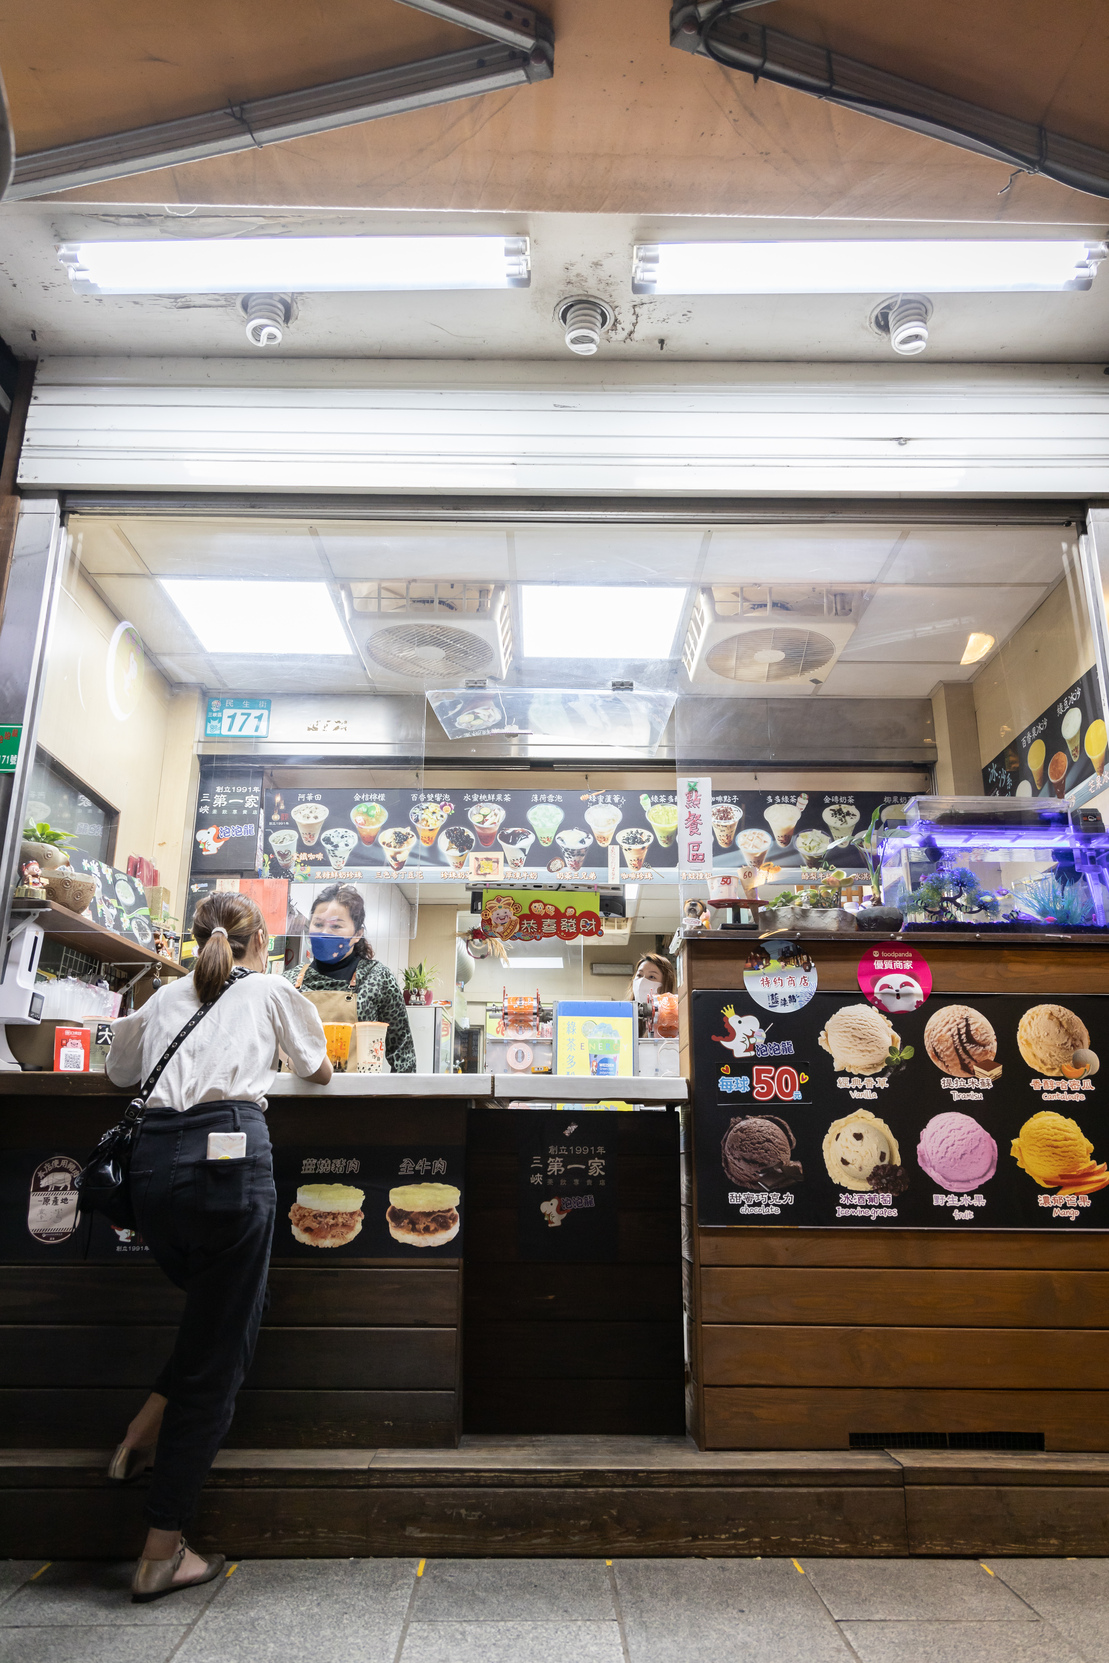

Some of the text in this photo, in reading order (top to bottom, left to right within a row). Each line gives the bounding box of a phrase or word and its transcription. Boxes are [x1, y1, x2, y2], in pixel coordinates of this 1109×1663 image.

[225, 699, 267, 709] 民生街
[226, 712, 265, 733] 171
[0, 754, 18, 766] 71號
[215, 785, 261, 794] 創立1991年
[212, 794, 260, 809] 第一家
[297, 793, 322, 802] 阿華田
[353, 793, 387, 802] 金桔檸檬
[462, 793, 512, 803] 水蜜桃鮮果茶
[765, 795, 798, 804] 多多綠茶
[883, 796, 912, 804] 椰果奶
[218, 823, 256, 839] 泡泡龍
[684, 790, 706, 864] 點餐區
[720, 877, 732, 885] 50
[742, 871, 753, 880] 60
[520, 917, 597, 933] 恭喜發財
[873, 960, 914, 970] 優質商家
[760, 975, 810, 988] 特約商店
[580, 1042, 628, 1051] ENERGY
[755, 1040, 796, 1059] 泡泡龍
[718, 1065, 803, 1102] 每球 50 元
[837, 1077, 890, 1089] 經典香草
[941, 1077, 994, 1090] 提拉米蘇
[1030, 1079, 1096, 1091] 香醇哈密瓜
[849, 1090, 879, 1100] Vanilla
[950, 1090, 984, 1101] Tiramisu
[1041, 1092, 1087, 1102] Cantaloupe
[548, 1145, 607, 1155] 創立1991年
[398, 1157, 448, 1175] 全牛肉
[529, 1156, 543, 1186] 三峽
[546, 1156, 606, 1177] 第一家
[42, 1196, 69, 1206] 原產地
[560, 1194, 596, 1210] 泡泡龍
[727, 1192, 795, 1205] 甜蜜巧克力
[839, 1193, 893, 1206] 冰酒葡萄
[932, 1194, 987, 1207] 野生水果
[1038, 1194, 1092, 1207] 濃郁芒果
[739, 1204, 781, 1215] chocolate
[952, 1209, 975, 1221] fruit
[1052, 1207, 1080, 1221] Mango
